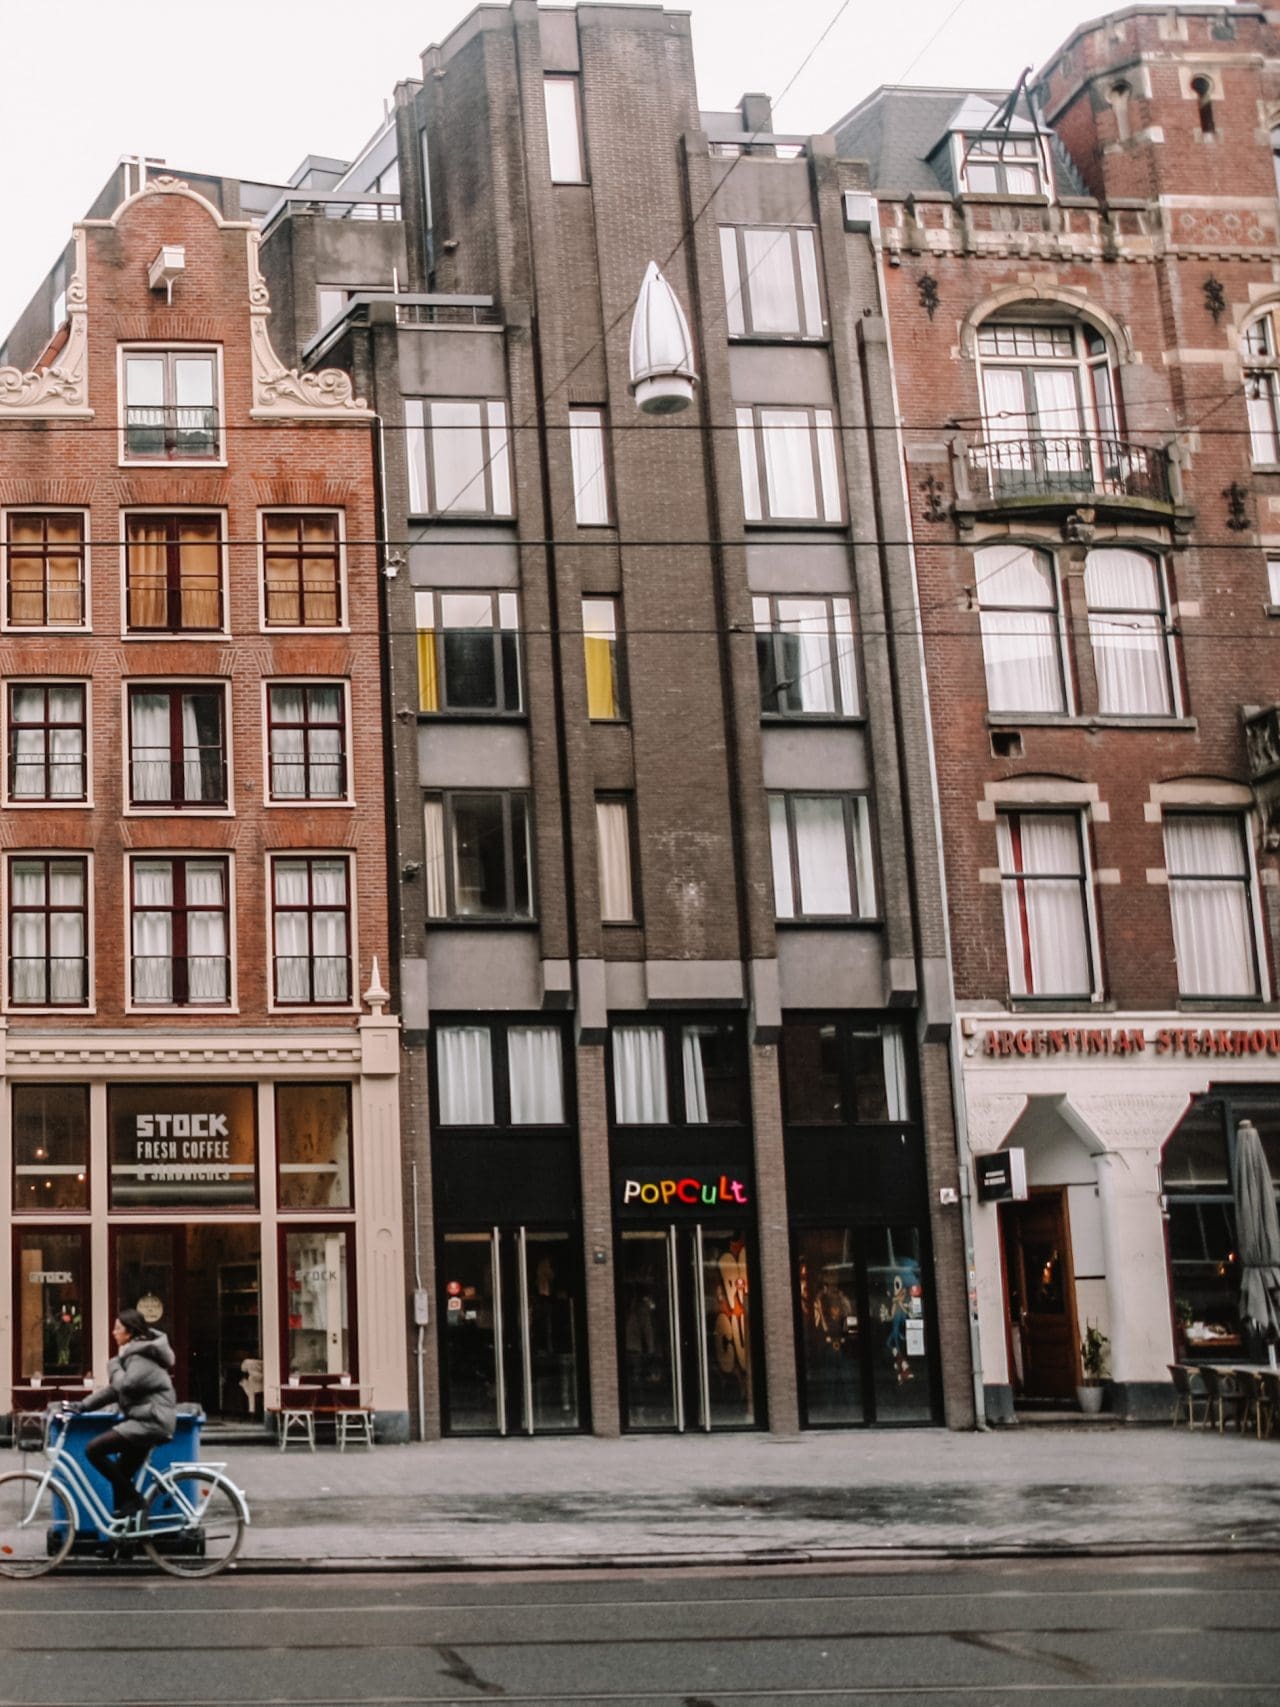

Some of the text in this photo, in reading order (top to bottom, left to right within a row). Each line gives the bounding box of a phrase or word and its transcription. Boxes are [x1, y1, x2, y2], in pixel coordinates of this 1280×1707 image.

[984, 1028, 1145, 1056] ARGENTINIAN
[136, 1114, 229, 1137] STOCK
[137, 1141, 230, 1159] FRESH COFFEE
[29, 1271, 72, 1284] STOCK
